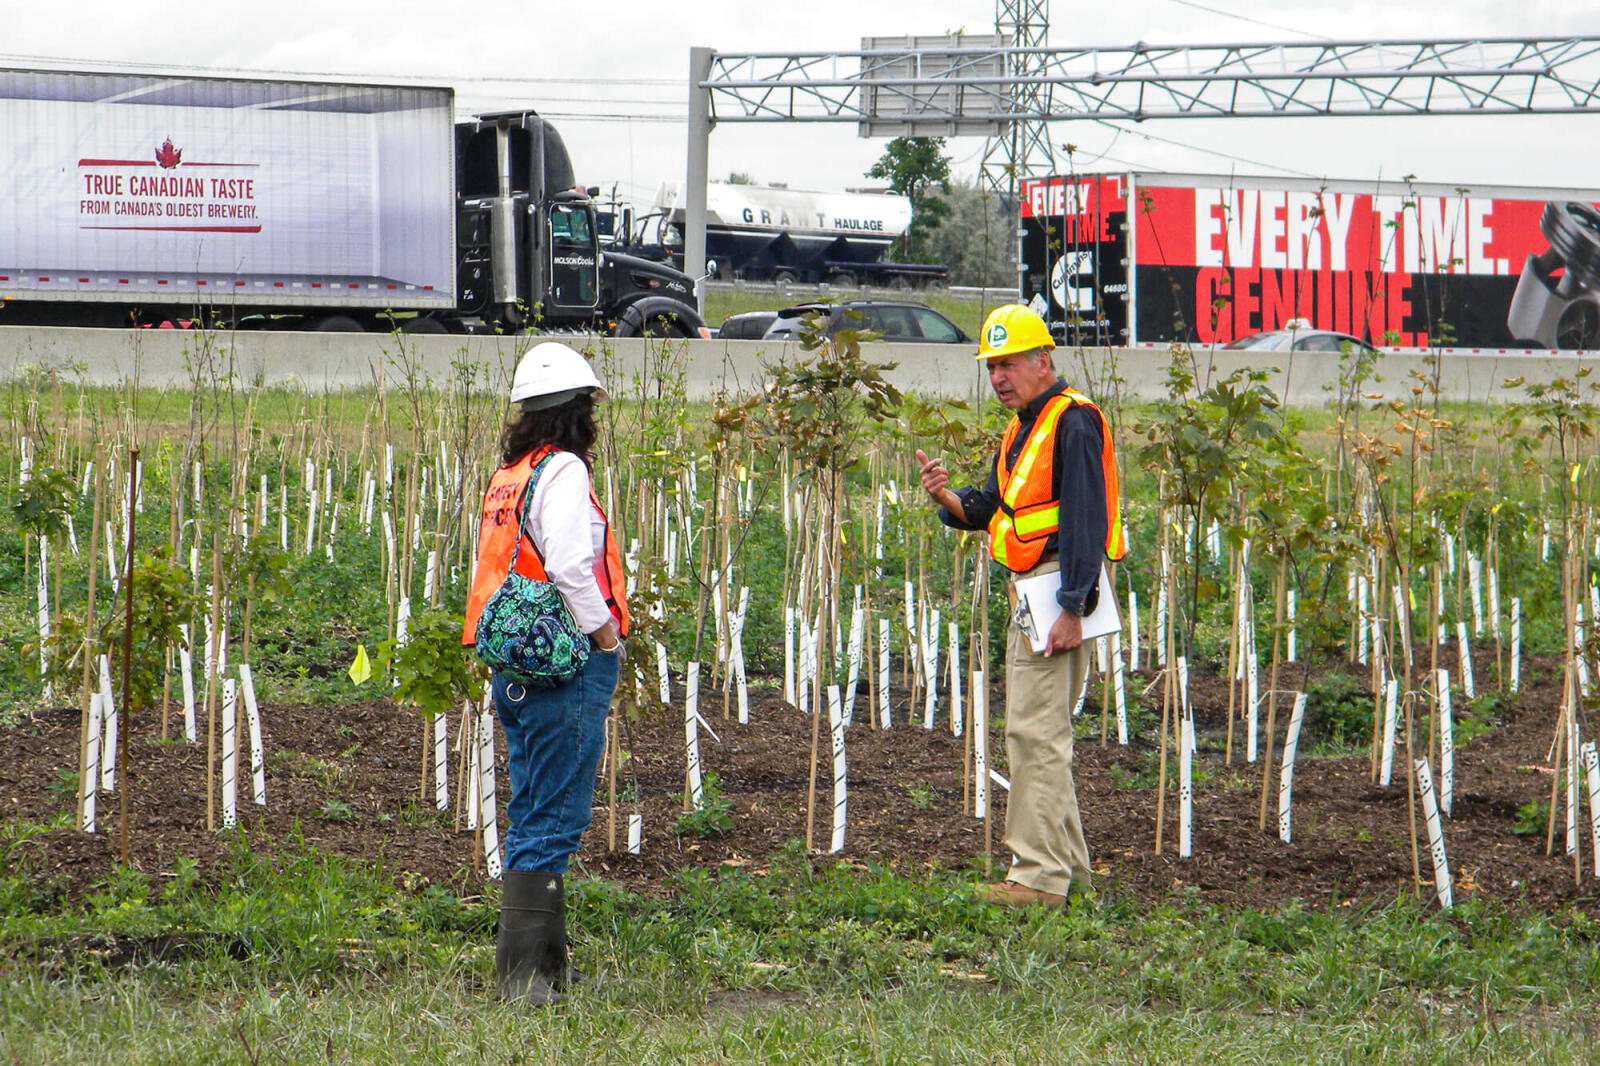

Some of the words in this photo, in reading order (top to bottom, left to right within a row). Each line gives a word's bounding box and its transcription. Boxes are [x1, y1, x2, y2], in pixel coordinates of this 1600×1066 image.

[84, 174, 123, 196] TRUE
[129, 175, 204, 198] CANADIAN
[210, 178, 254, 200] TASTE
[1032, 183, 1091, 218] EVERY
[80, 199, 110, 215] FROM
[114, 201, 163, 217] CANADA'S
[166, 202, 204, 218] OLDEST
[207, 204, 259, 219] BREWERY.
[743, 208, 825, 228] GRANT
[834, 217, 884, 231] HAULAGE
[1066, 211, 1116, 244] TIME.
[1195, 187, 1355, 272] EVERY
[1371, 193, 1510, 275] TIME.
[553, 256, 577, 265] MOLSON
[1195, 266, 1429, 348] GENUINE.
